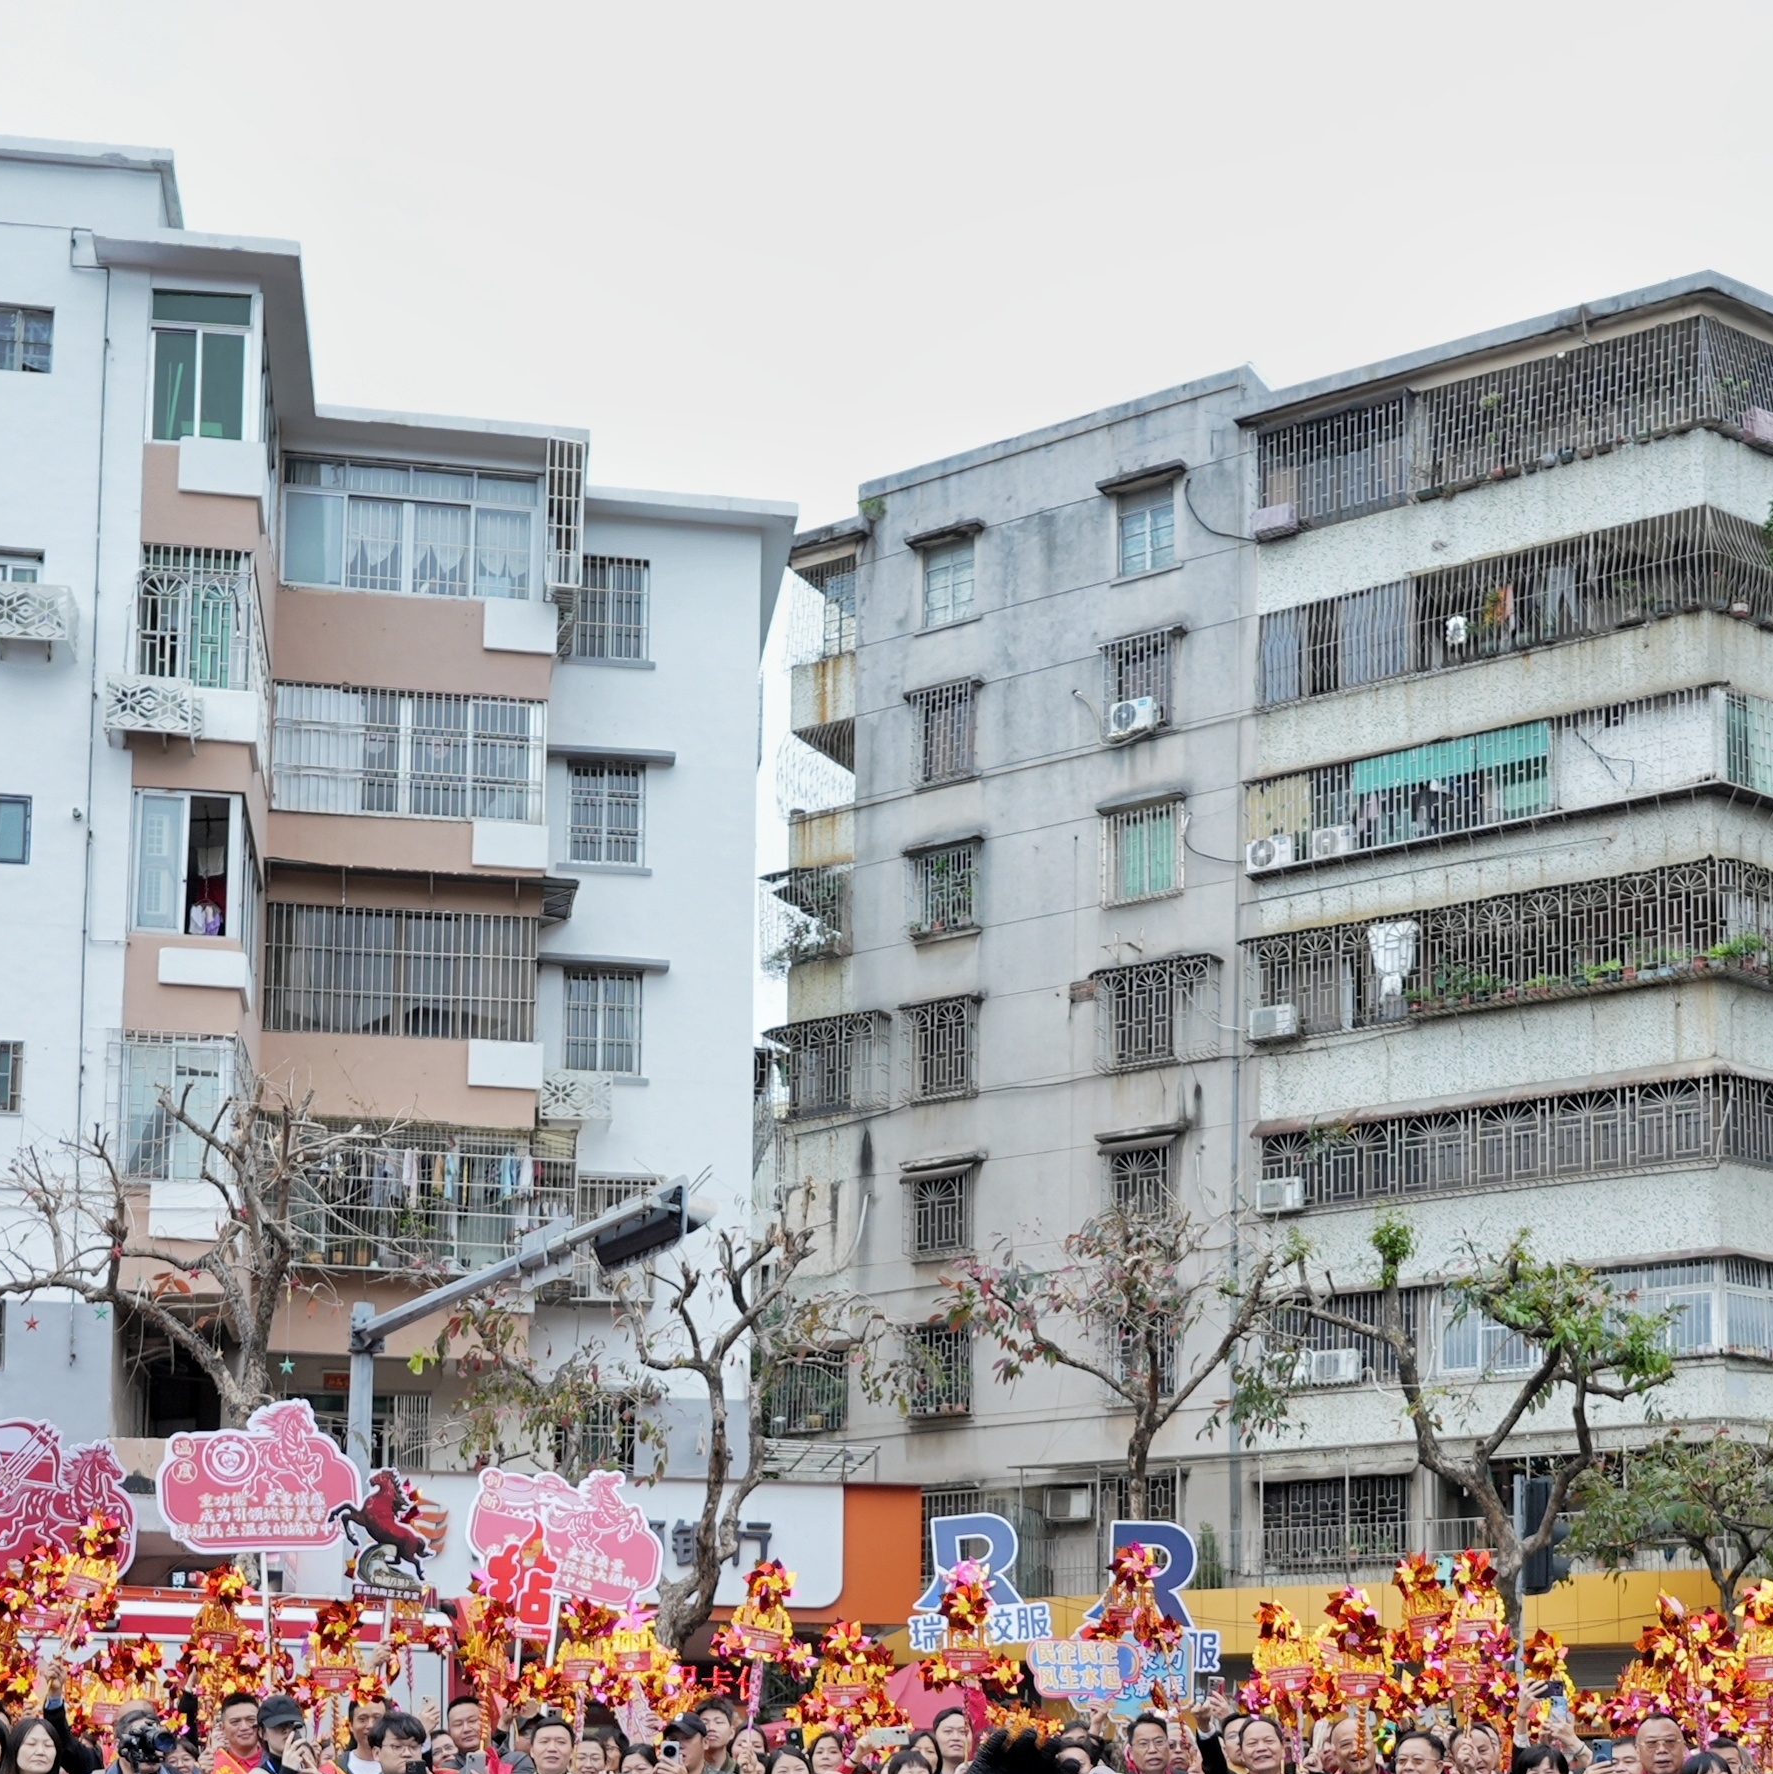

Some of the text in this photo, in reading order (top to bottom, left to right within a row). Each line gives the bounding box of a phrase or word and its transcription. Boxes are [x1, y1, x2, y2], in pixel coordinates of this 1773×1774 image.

[1035, 1640, 1119, 1665] 民企民企
[1038, 1666, 1122, 1690] 风生水起
